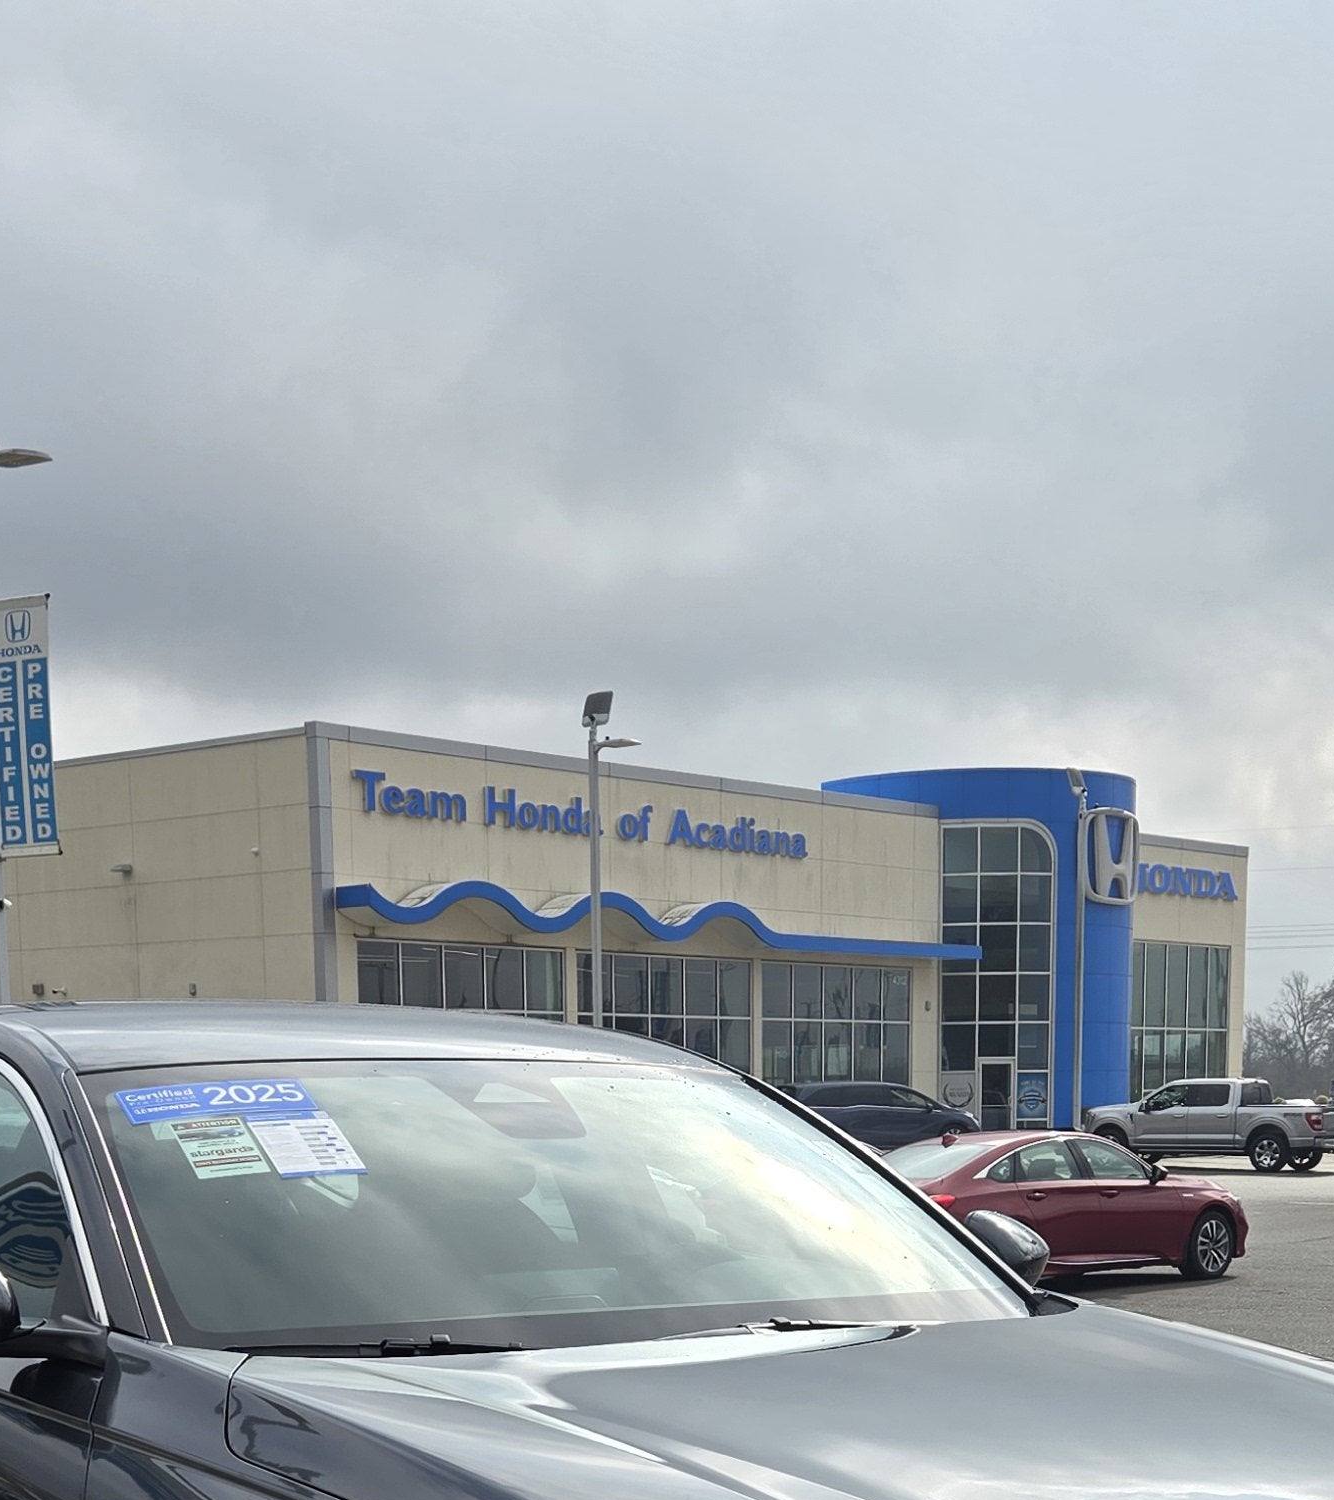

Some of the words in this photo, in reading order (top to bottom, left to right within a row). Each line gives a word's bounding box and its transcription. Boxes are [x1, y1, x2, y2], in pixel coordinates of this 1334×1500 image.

[27, 662, 45, 719] PRE
[29, 743, 52, 840] OWNED
[351, 769, 466, 822] Team
[617, 804, 654, 842] of
[666, 809, 809, 859] Acadiana
[124, 1087, 194, 1102] Certified
[202, 1083, 305, 1106] 2025
